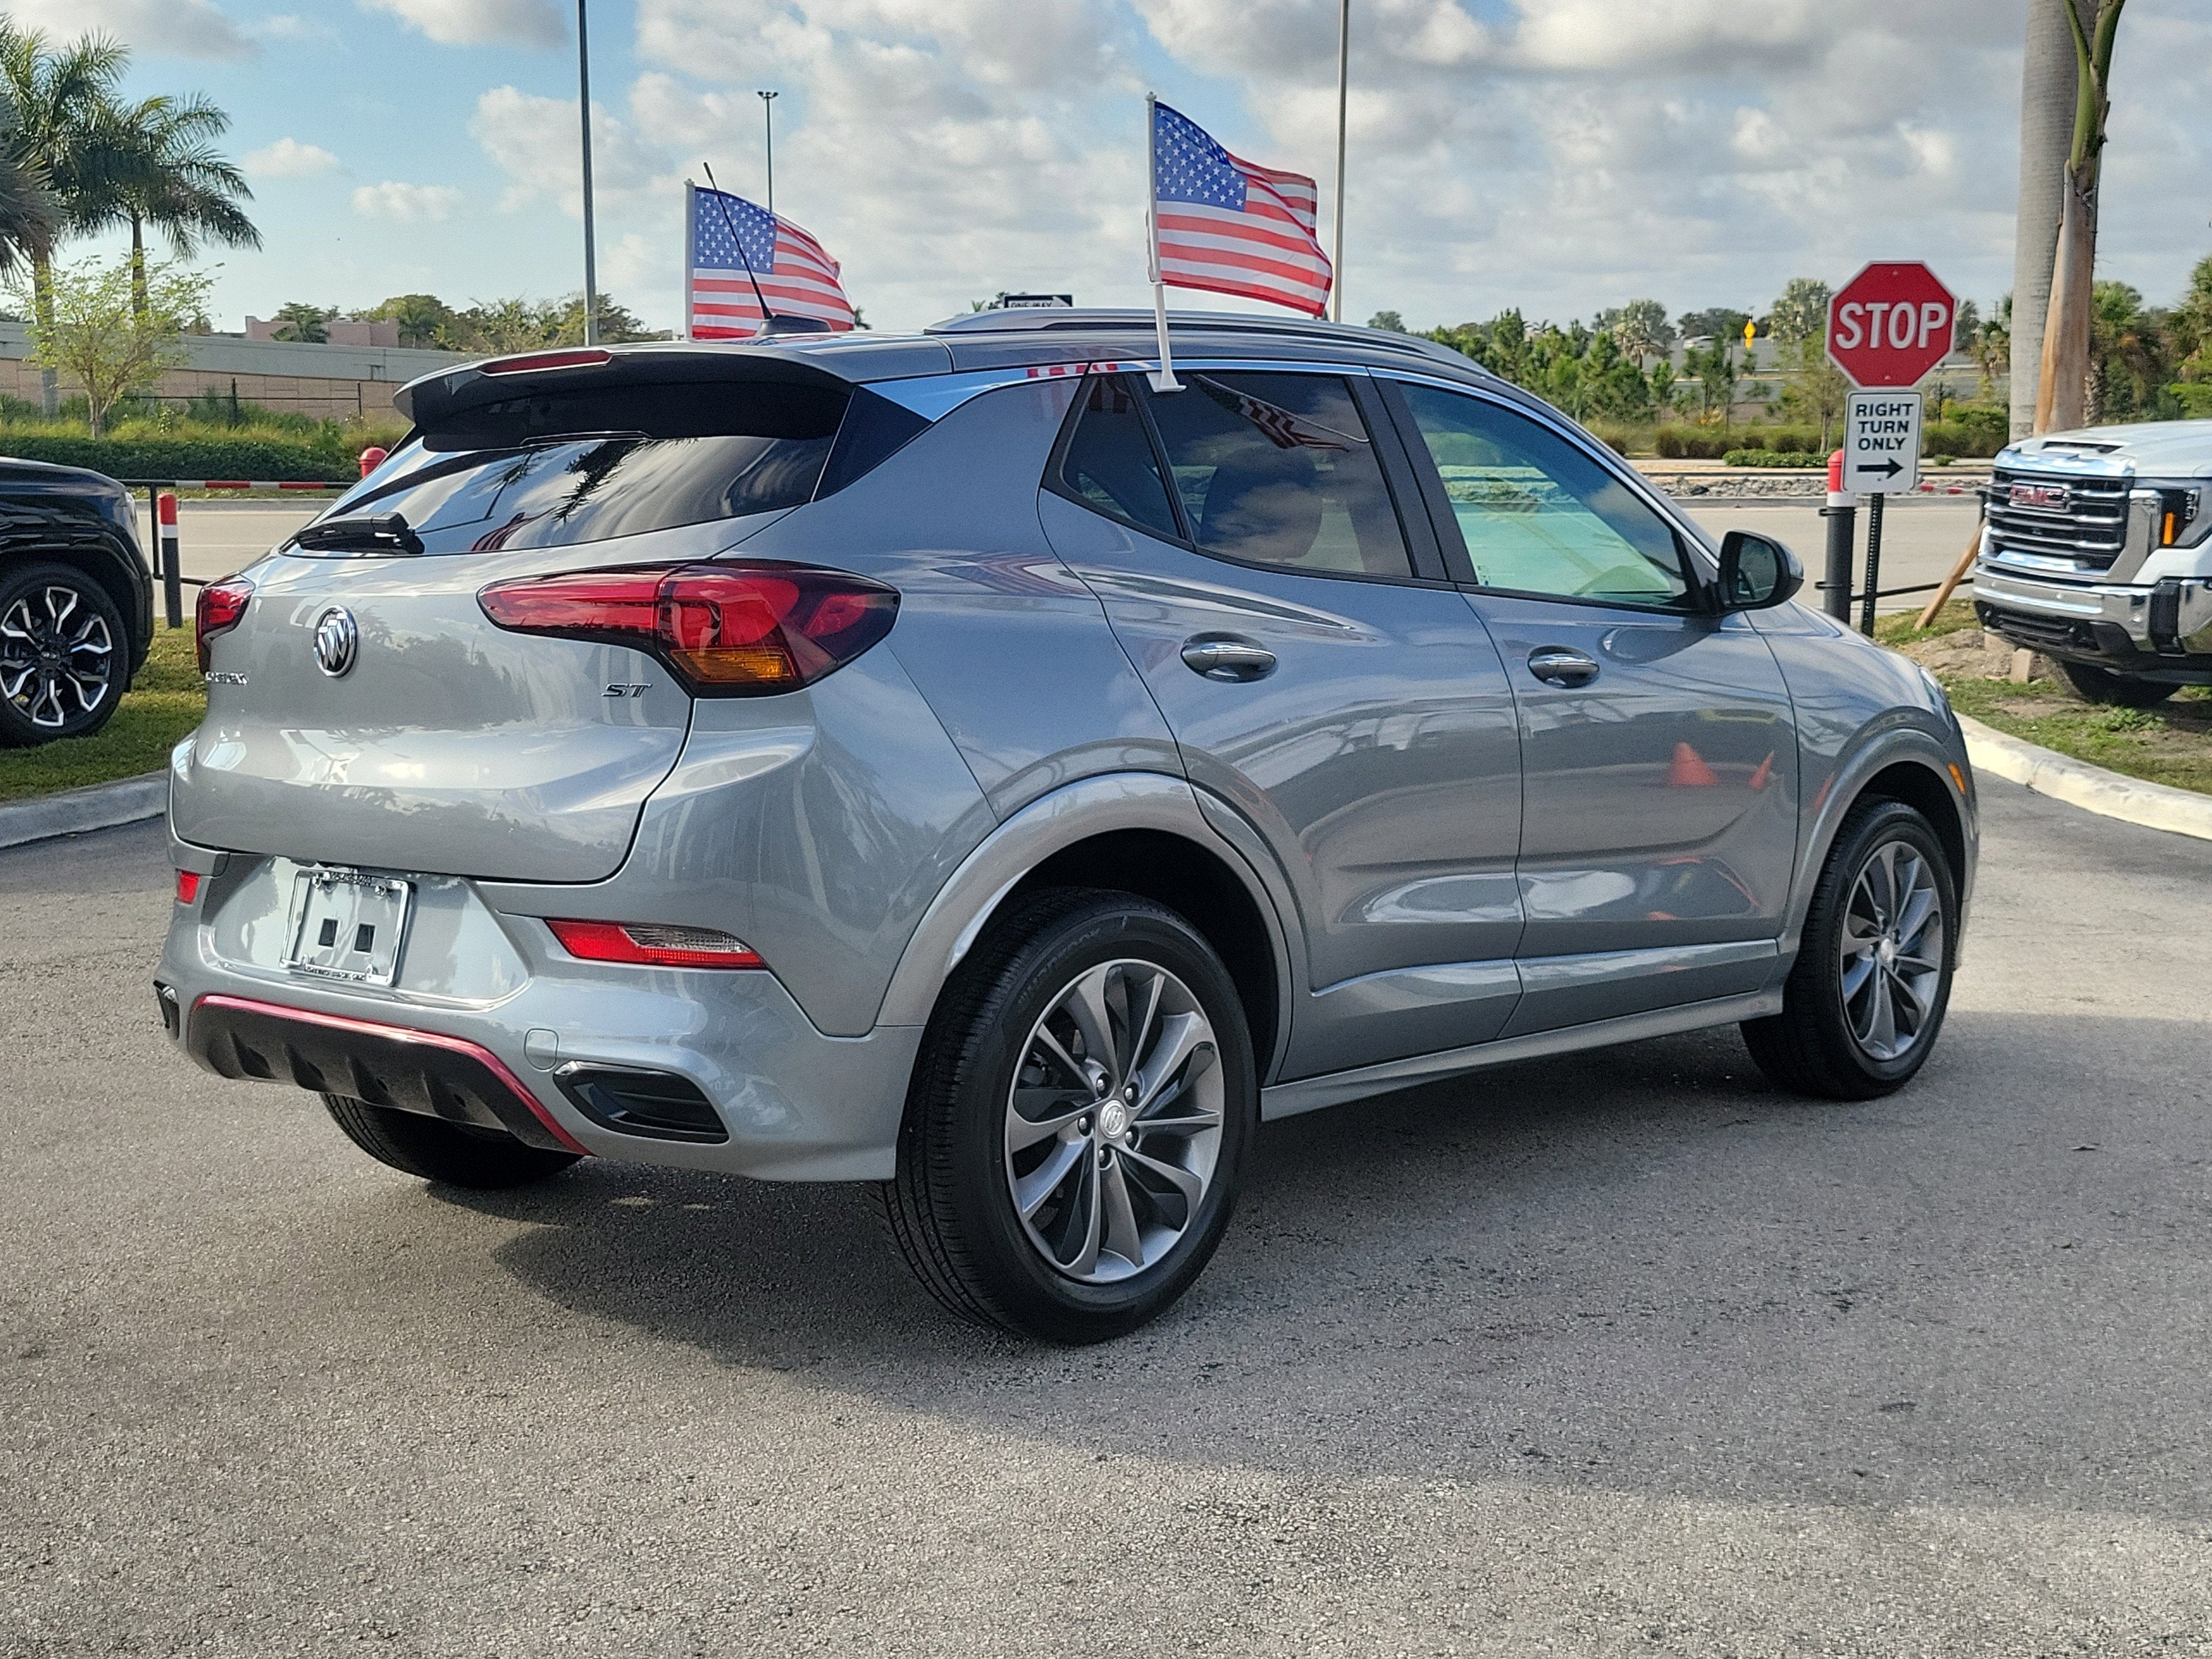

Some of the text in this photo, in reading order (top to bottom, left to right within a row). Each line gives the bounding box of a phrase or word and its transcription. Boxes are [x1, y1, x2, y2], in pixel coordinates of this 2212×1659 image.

[1836, 302, 1948, 349] STOP
[1856, 404, 1913, 416] RIGHT
[1858, 421, 1909, 433] TURN
[1858, 437, 1906, 450] ONLY
[601, 683, 653, 697] ST
